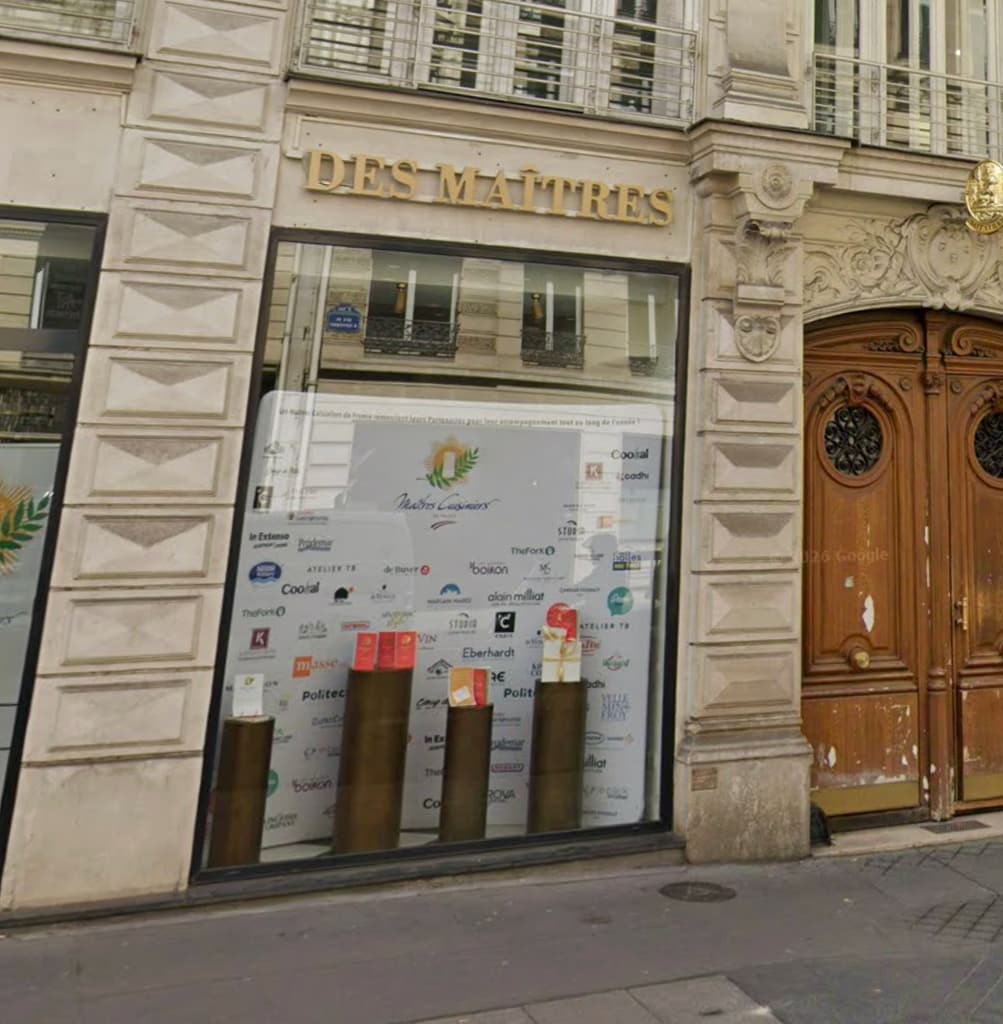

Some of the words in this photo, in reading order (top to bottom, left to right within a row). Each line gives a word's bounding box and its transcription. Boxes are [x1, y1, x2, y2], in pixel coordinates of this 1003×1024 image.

[304, 149, 419, 202] DES
[435, 163, 674, 226] MAÎTRES
[463, 647, 515, 658] Eberhardt
[504, 688, 534, 698] Polit
